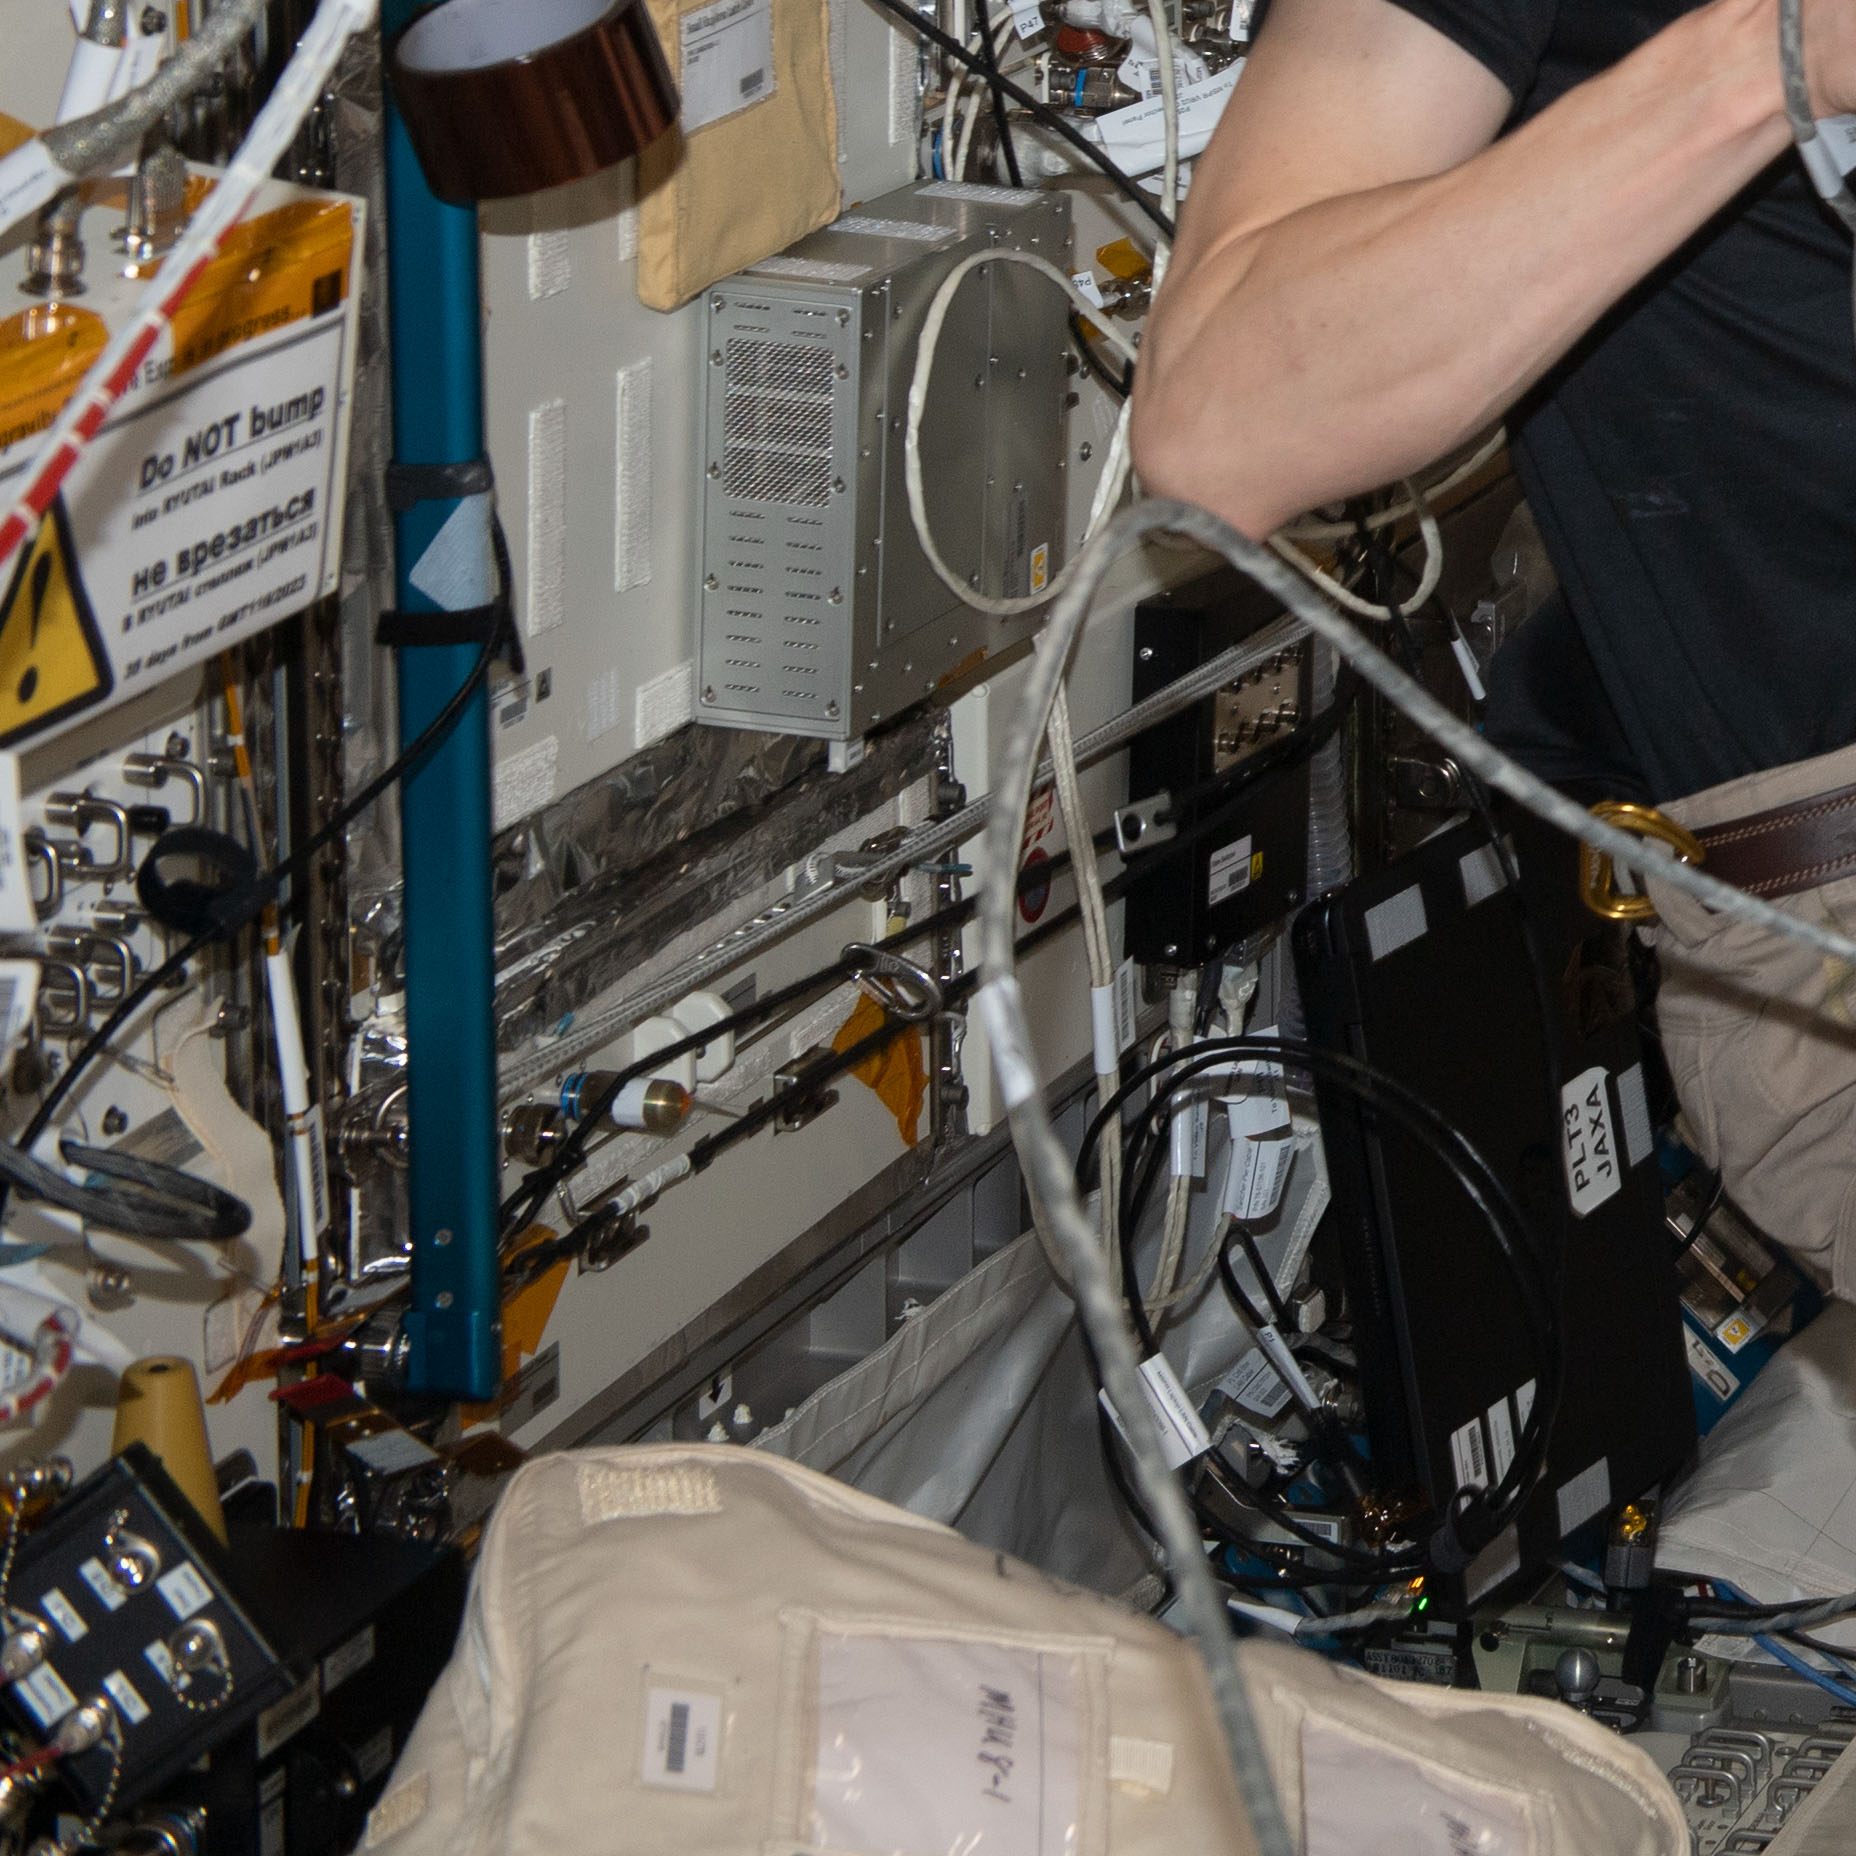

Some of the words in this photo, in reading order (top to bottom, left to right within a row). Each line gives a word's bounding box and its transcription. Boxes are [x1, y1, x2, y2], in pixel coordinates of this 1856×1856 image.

[1019, 14, 1039, 33] P47
[139, 453, 176, 490] Do
[182, 411, 242, 469] NOT
[249, 384, 325, 438] bump
[130, 558, 168, 598] не
[175, 486, 317, 578] врезаться
[1563, 1102, 1592, 1195] PLT3
[1585, 1085, 1621, 1180] JAXA
[1263, 1330, 1276, 1343] P1
